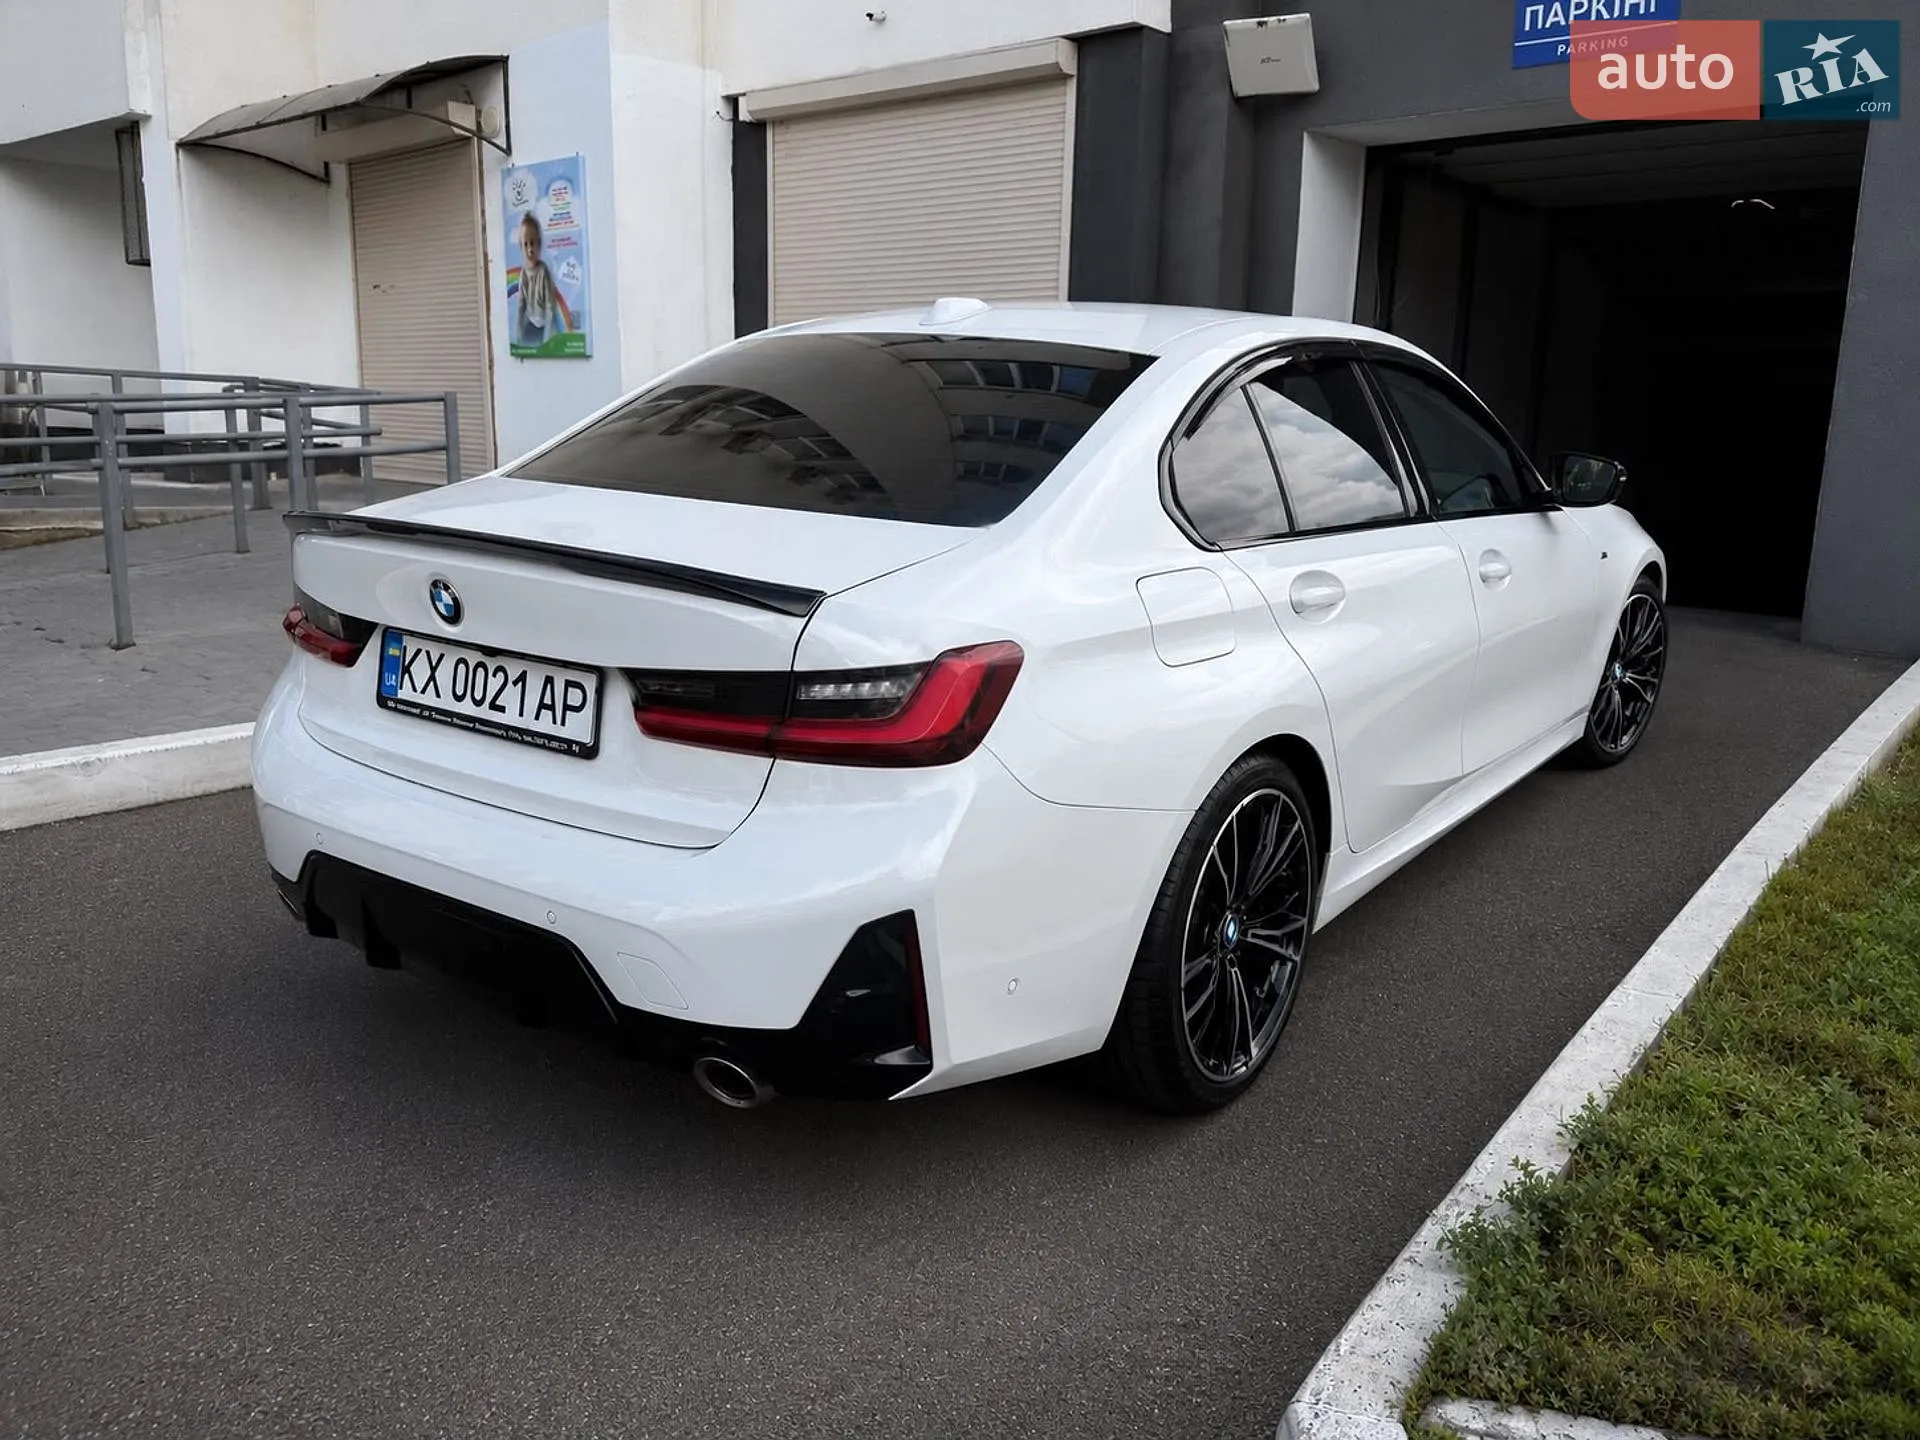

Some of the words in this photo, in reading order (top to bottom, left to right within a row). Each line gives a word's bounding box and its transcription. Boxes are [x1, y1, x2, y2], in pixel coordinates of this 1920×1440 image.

[1557, 36, 1629, 56] PARKING
[400, 645, 445, 698] KX
[451, 657, 528, 717] 0021
[534, 675, 588, 727] AP
